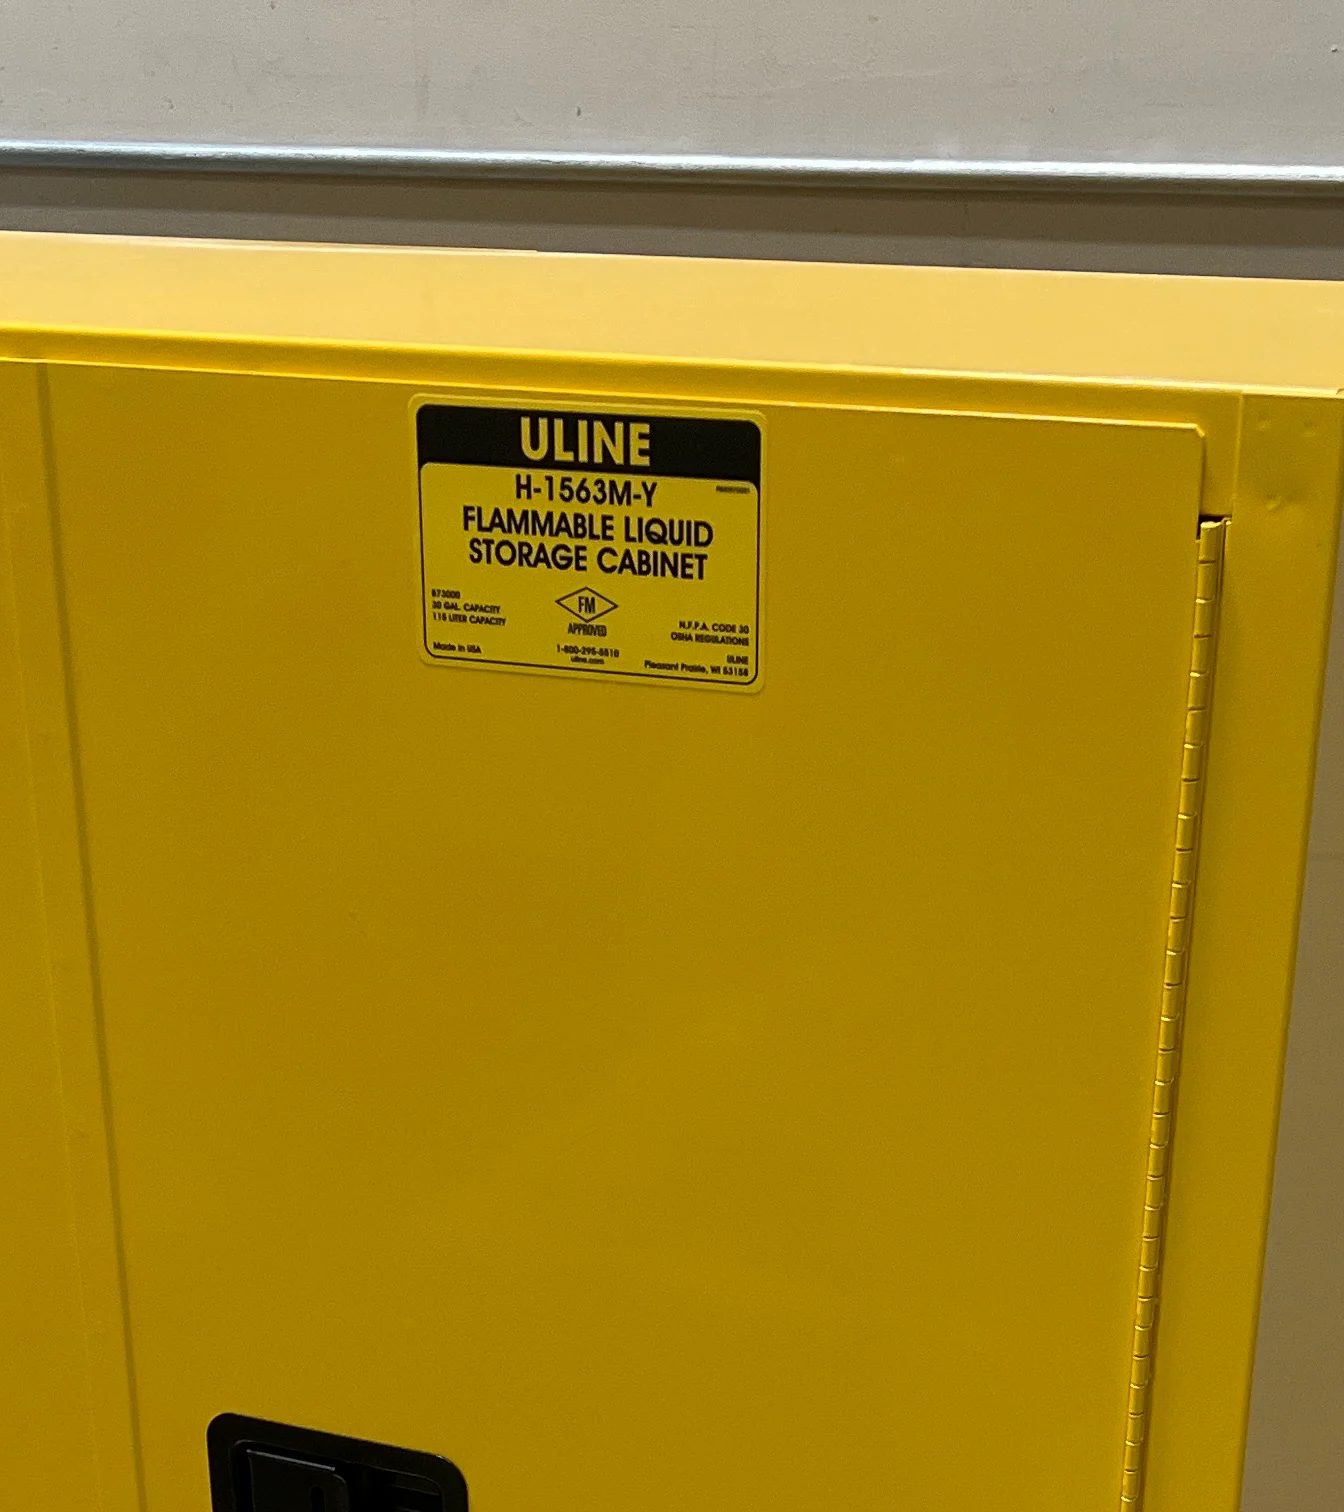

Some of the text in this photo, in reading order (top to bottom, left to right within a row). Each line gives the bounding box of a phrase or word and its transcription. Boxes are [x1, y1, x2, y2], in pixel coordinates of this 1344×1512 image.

[520, 416, 650, 467] ULINE
[515, 474, 657, 508] H-1563M-Y
[463, 506, 713, 547] FLAMMABLE LIQUID
[468, 538, 708, 580] STORAGE CABINET
[432, 601, 441, 609] 30
[463, 603, 501, 613] CAPACITY
[578, 596, 595, 614] FM
[449, 614, 467, 622] LITER
[469, 615, 506, 626] CAPACITY
[679, 620, 749, 634] N.F.P.A. CODE 30
[568, 623, 607, 637] APPROVED
[671, 632, 749, 646] OSHA REGULATIONS
[433, 642, 481, 654] Made in USA
[571, 656, 604, 664] uline.com
[644, 660, 678, 670] Pleasant
[681, 663, 708, 674] Prairie,
[710, 666, 720, 674] WI
[727, 655, 748, 665] ULINE
